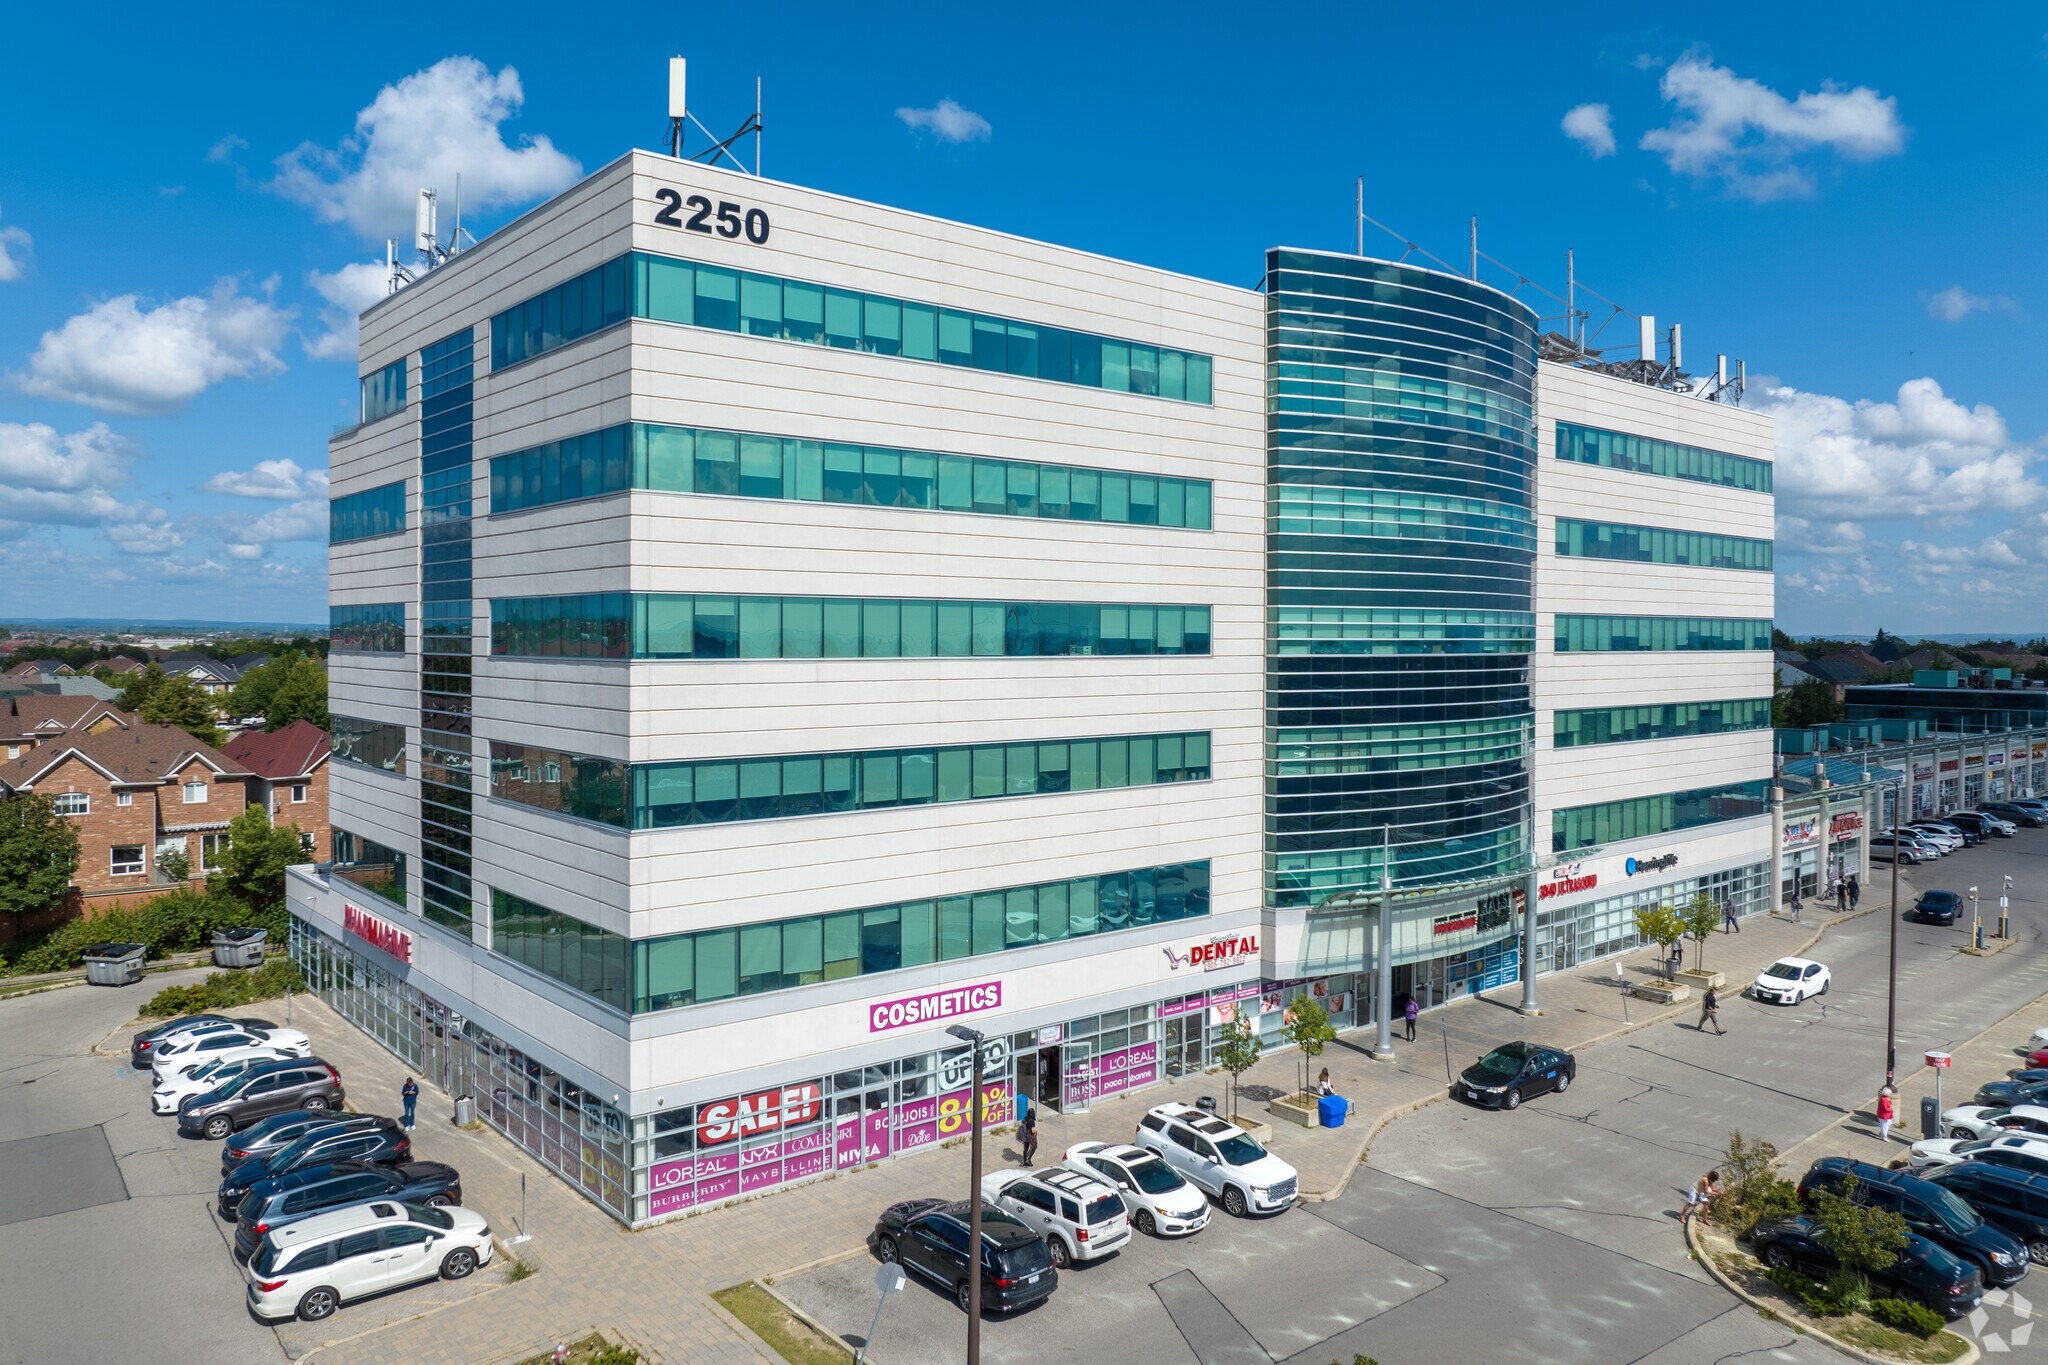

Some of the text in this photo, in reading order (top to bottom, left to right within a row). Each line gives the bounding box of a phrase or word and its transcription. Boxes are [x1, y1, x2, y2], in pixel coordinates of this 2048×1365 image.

[654, 188, 770, 245] 2250
[1190, 936, 1260, 964] DENTAL
[873, 985, 999, 1029] COSMETICS
[944, 1056, 972, 1085] UP
[1109, 1050, 1155, 1070] L'ORÉAL
[1071, 1082, 1096, 1098] BOSS
[1104, 1070, 1152, 1090] paco rbanne
[705, 1086, 811, 1139] SALE!
[875, 1106, 928, 1130] BOURJOIS
[939, 1087, 1011, 1133] 80%
[988, 1108, 1012, 1123] OFF
[907, 1131, 931, 1147] Dove
[741, 1143, 779, 1165] NYX
[839, 1143, 881, 1165] NIVEA
[655, 1158, 727, 1187] L'ORÉAL
[741, 1155, 831, 1185] MAYBELLINE
[813, 1164, 831, 1173] YOK
[652, 1181, 729, 1208] BURBERRY
